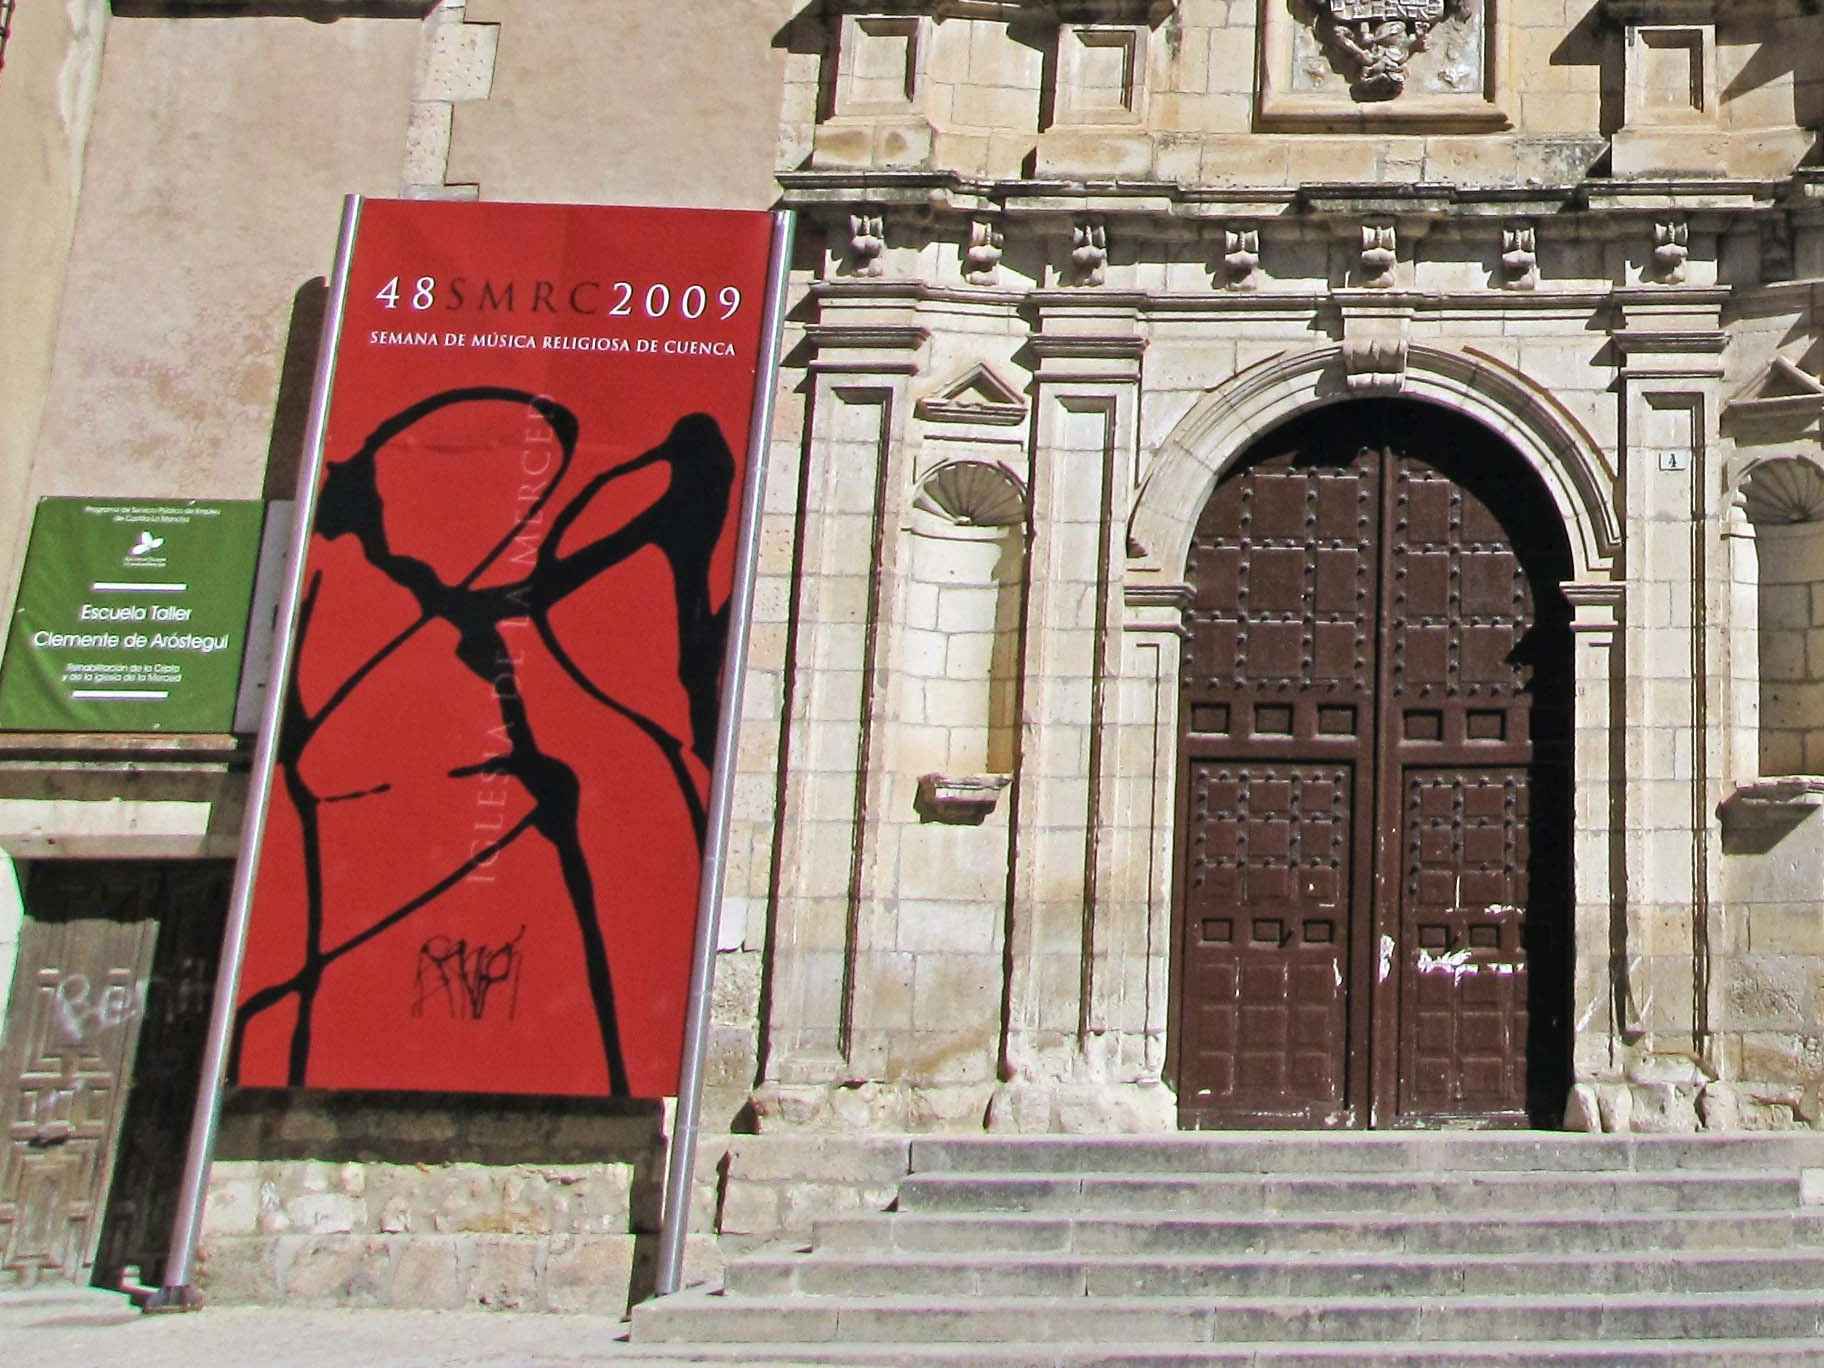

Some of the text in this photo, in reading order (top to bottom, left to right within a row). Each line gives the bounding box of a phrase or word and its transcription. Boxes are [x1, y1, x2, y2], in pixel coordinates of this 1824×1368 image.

[370, 330, 736, 356] SEMANA DE MÚSICA RELIGIOSA DE CUENCA
[80, 605, 192, 621] Escuela Taller
[33, 631, 229, 652] Clemente de Aróstegui
[465, 393, 555, 883] IGLESIA DE LA MERCED
